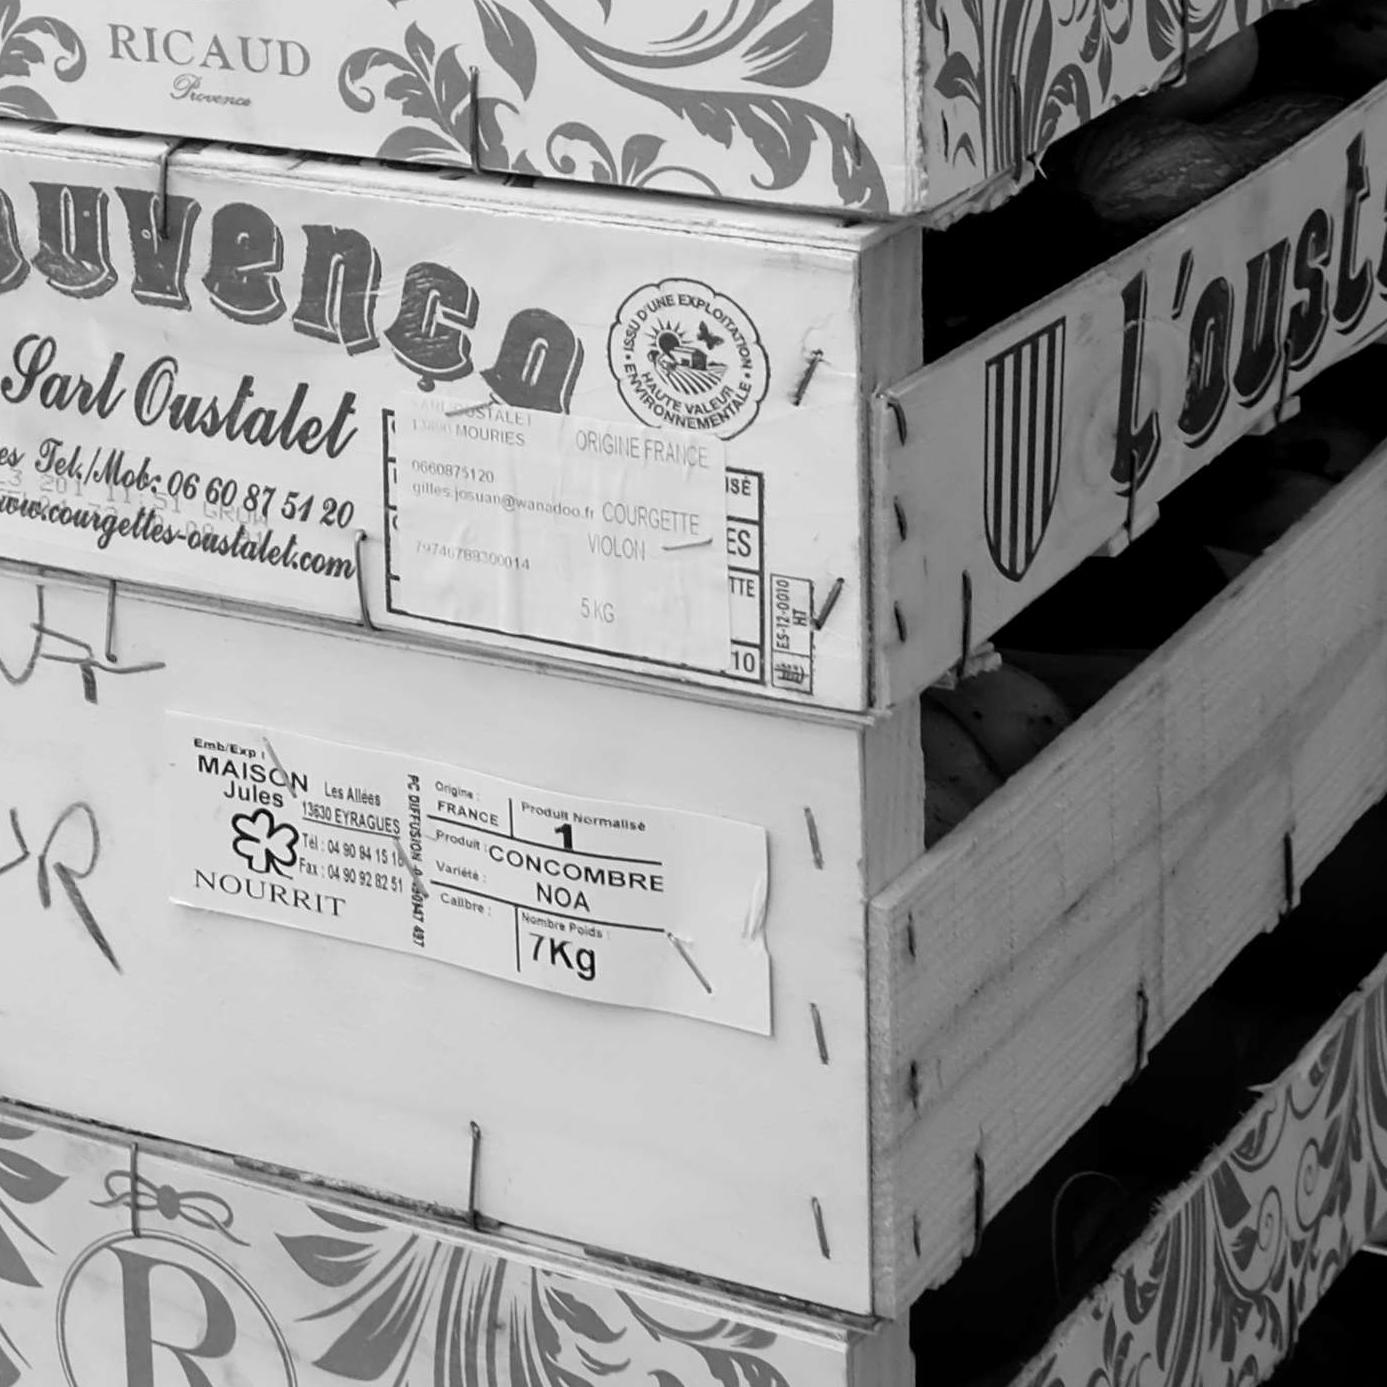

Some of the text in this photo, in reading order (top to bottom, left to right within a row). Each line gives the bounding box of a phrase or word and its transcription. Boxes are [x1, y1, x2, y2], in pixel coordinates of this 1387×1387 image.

[107, 22, 311, 77] RICAUD
[169, 72, 252, 108] Provence
[677, 293, 753, 370] EXPLOITATION
[0, 332, 359, 461] Sarl Oustalet
[623, 362, 753, 431] ENVIRONNEMENTALE
[640, 371, 736, 416] HAUTE VALEUR
[456, 422, 526, 447] MOURIES
[575, 428, 710, 470] ORIGINE FRANCE
[411, 458, 495, 484] 0660875120
[167, 466, 199, 500] 06
[205, 472, 238, 507] 60
[245, 479, 275, 514] 87
[280, 487, 315, 523] 51
[319, 494, 356, 530] 20
[602, 501, 701, 537] COURGETTE
[587, 532, 647, 563] VIOLON
[579, 597, 616, 625] 5 KG
[731, 649, 755, 675] 10
[197, 753, 309, 794] MAISON
[435, 780, 474, 799] Origine
[223, 779, 284, 809] Jules
[324, 781, 344, 801] Les
[302, 800, 401, 835] 13630 EYRAGUES
[437, 799, 499, 827] FRANCE
[521, 801, 573, 821] Produit
[407, 794, 423, 863] DIFFUSION
[554, 822, 575, 851] 1
[327, 839, 340, 855] 04
[342, 841, 357, 858] 90
[327, 863, 340, 880] 04
[342, 866, 357, 883] 90
[487, 845, 666, 893] CONCOMBRE
[195, 868, 347, 918] NOURRIT
[439, 892, 484, 914] Calibre
[536, 881, 591, 914] NOA
[521, 911, 604, 939] Nombre Poids
[528, 930, 597, 982] 7Kg
